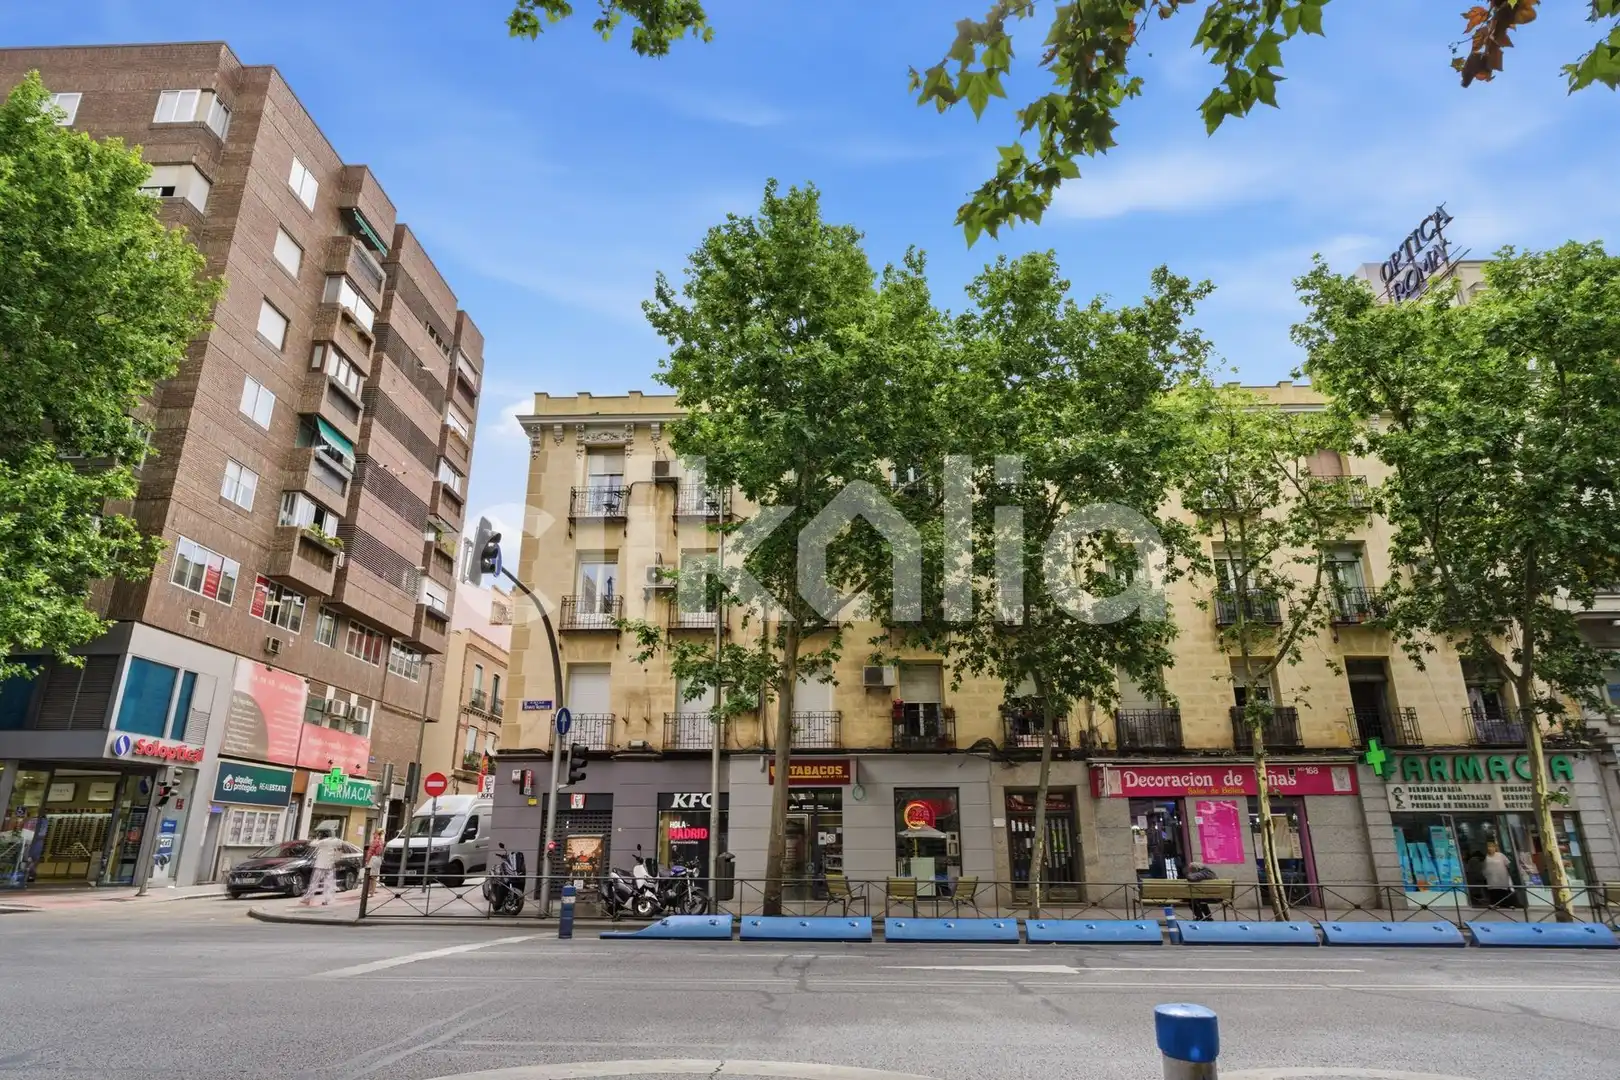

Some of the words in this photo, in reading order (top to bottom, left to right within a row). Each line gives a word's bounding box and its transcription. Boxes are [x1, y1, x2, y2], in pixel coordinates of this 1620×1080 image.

[1380, 206, 1454, 284] OPTICA
[135, 738, 205, 763] Soloptical
[789, 765, 844, 775] TABACOS
[1383, 753, 1575, 782] FARMACA
[1123, 771, 1214, 787] Decoracion
[1223, 769, 1244, 786] de
[671, 793, 712, 808] KFC
[669, 828, 708, 840] MADRID
